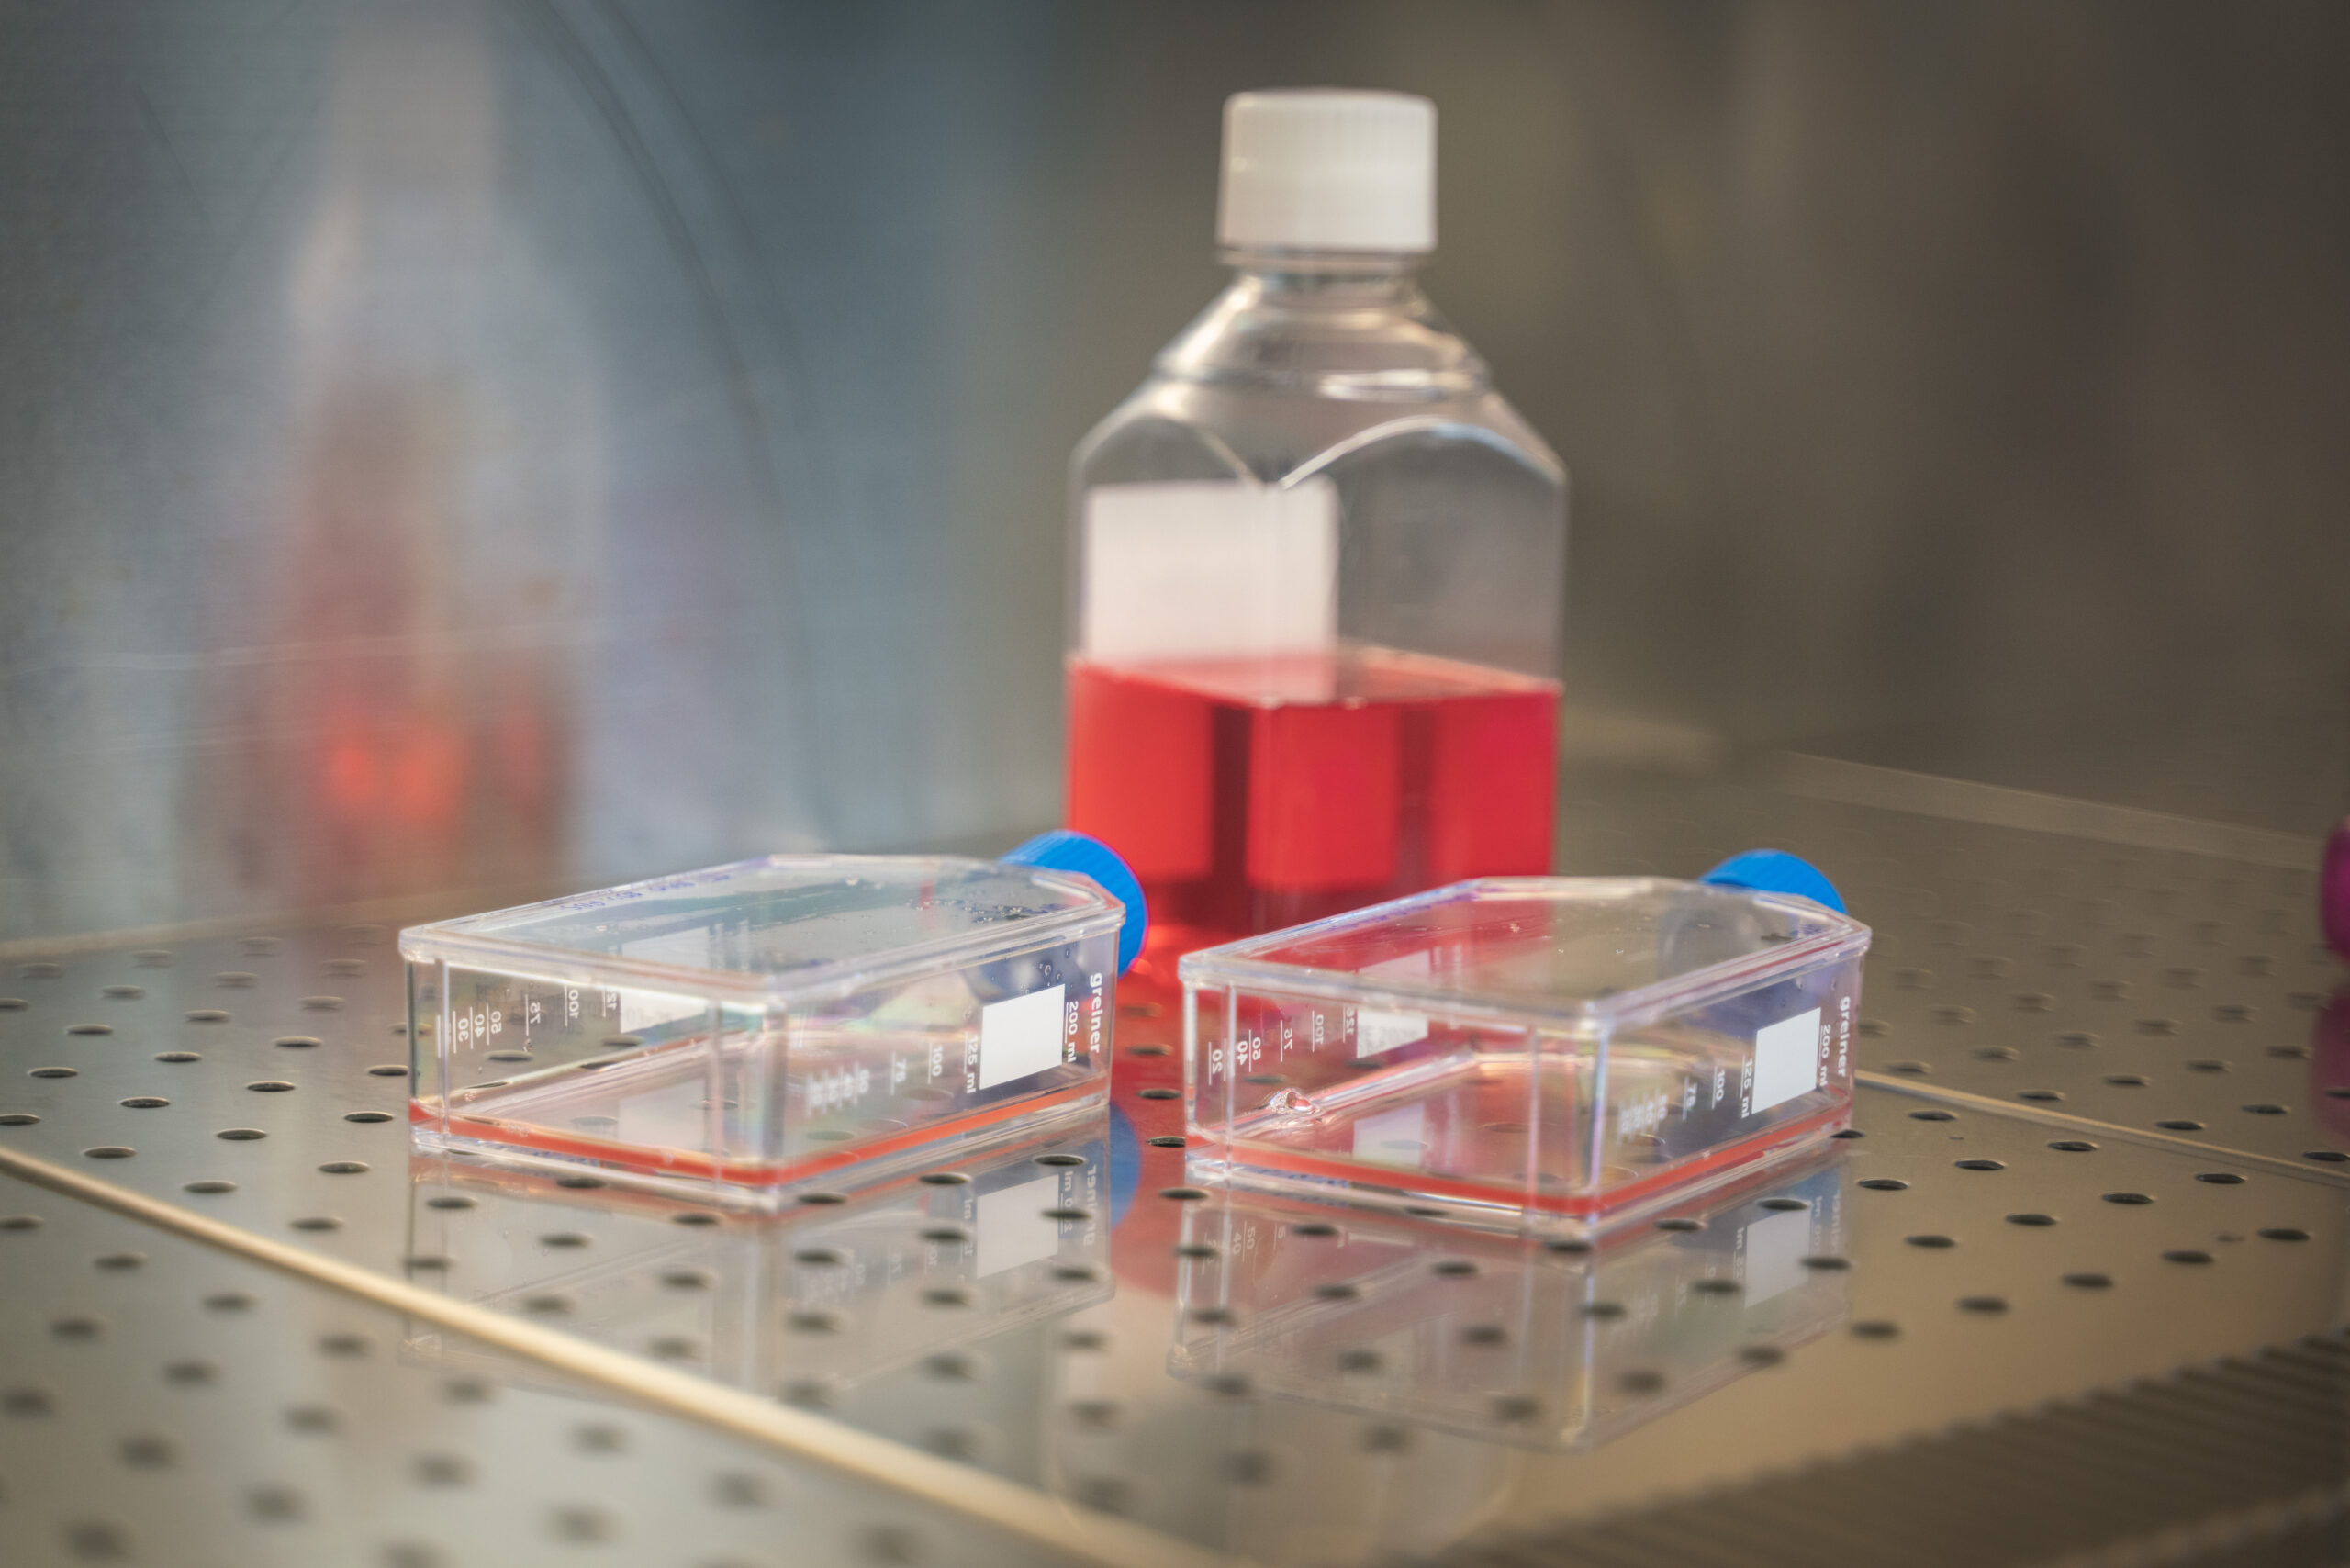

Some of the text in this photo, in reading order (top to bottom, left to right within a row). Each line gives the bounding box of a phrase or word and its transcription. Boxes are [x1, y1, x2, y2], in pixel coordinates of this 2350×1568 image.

[1068, 1001, 1079, 1063] 200 ml
[1090, 972, 1103, 1054] greiner
[1837, 996, 1851, 1078] greiner
[895, 1058, 906, 1083] 75
[931, 1045, 943, 1077] 100
[967, 1034, 979, 1093] 125 ml
[1716, 1069, 1725, 1102] 100
[1819, 1024, 1830, 1087] 200 ml
[1741, 1058, 1753, 1119] 125 ml
